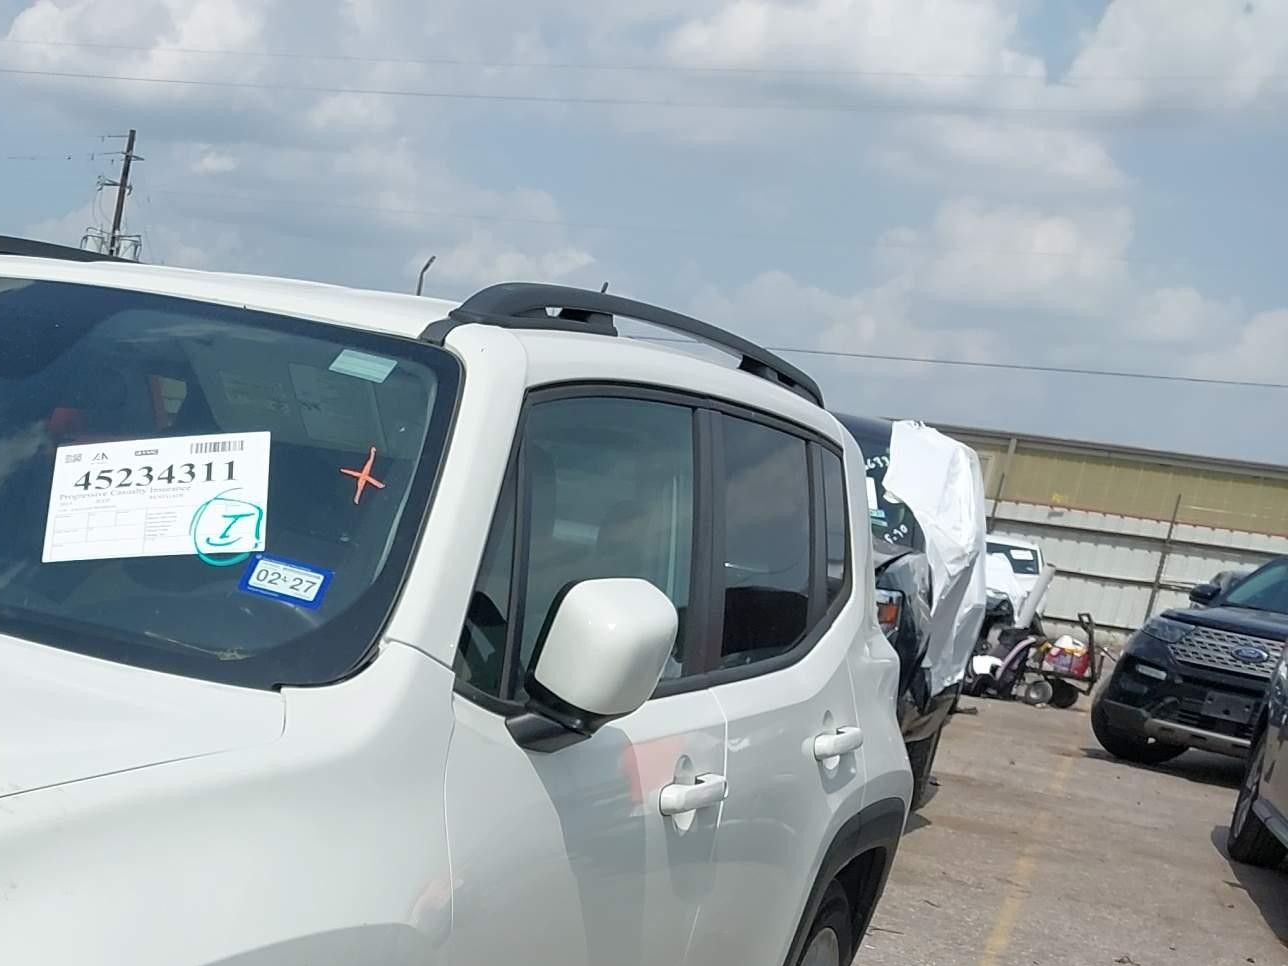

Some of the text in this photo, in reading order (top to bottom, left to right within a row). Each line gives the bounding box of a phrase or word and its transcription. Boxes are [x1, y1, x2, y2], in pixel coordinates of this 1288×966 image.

[73, 460, 238, 491] 45234311
[59, 486, 192, 501] Progressive Casualty Insurance
